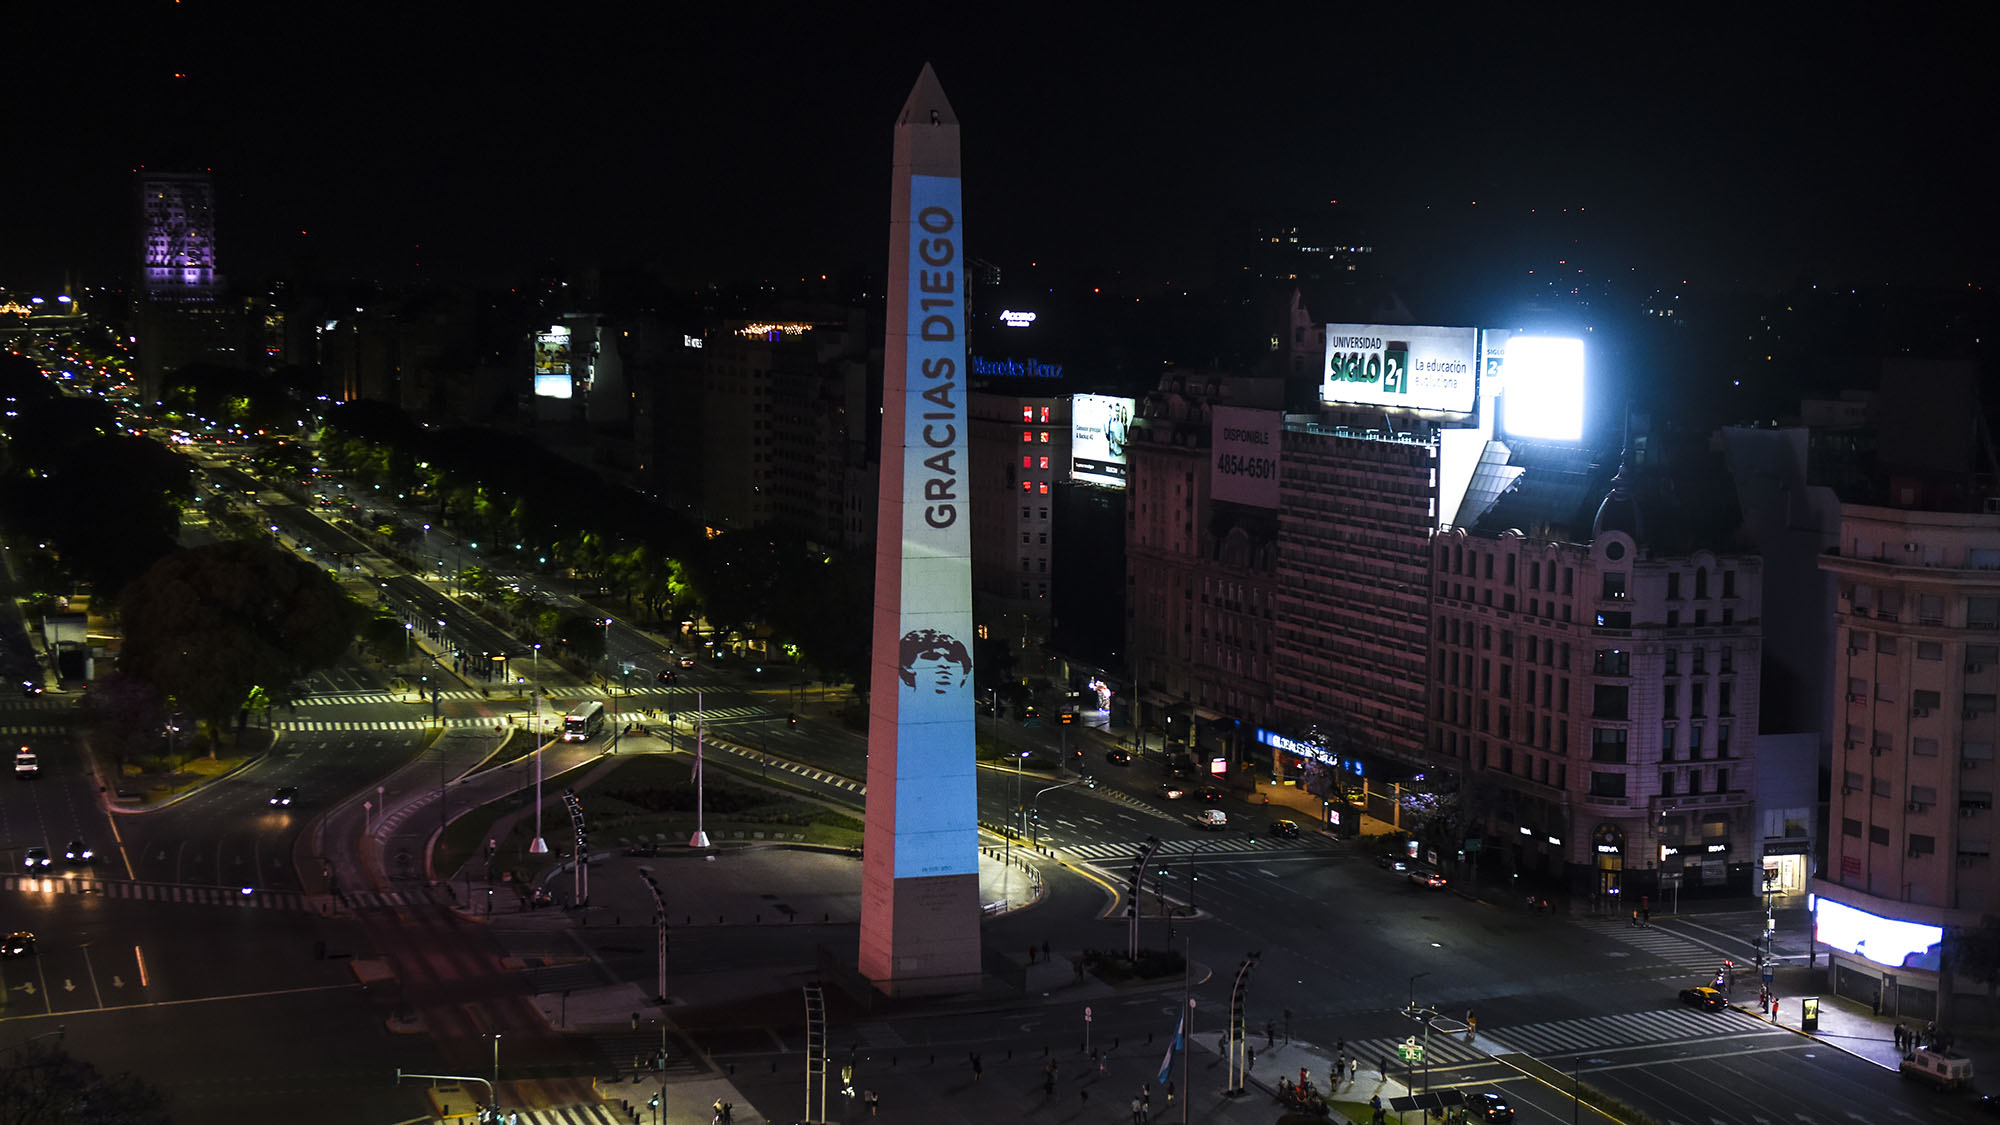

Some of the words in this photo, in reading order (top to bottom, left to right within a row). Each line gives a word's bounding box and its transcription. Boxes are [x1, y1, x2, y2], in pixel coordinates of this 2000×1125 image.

[1333, 336, 1382, 350] UNIVERSIDAD
[973, 355, 1064, 378] Mercedes-Benz
[1331, 351, 1382, 384] SIGLO
[1385, 358, 1404, 394] 21
[1415, 358, 1424, 371] La
[1426, 359, 1467, 374] educación
[922, 357, 957, 529] GRACIAS
[1223, 427, 1270, 445] DISPONIBLE
[1217, 453, 1276, 481] 4854-6501
[1598, 845, 1619, 853] BBVA
[1708, 844, 1725, 853] BBVA
